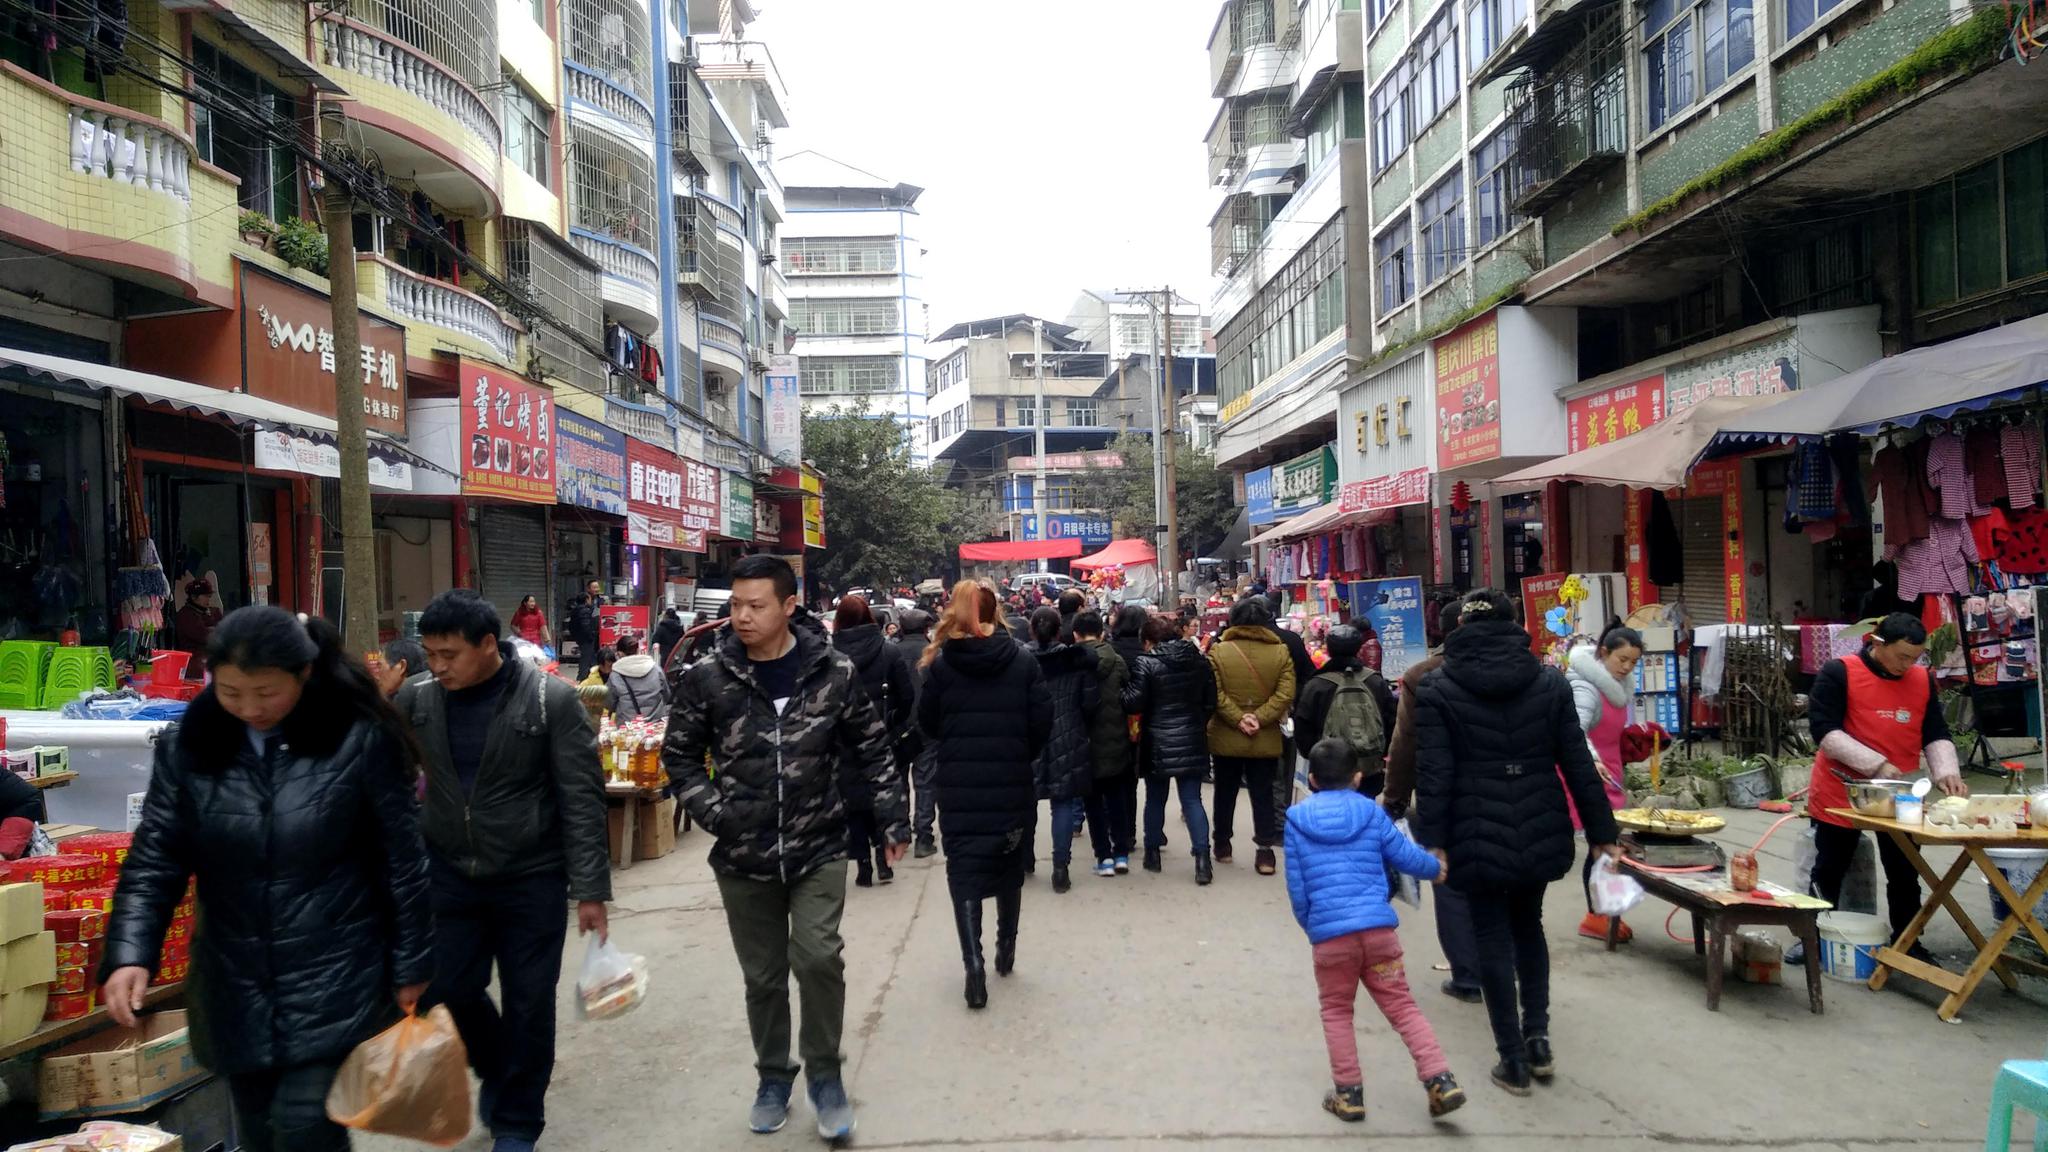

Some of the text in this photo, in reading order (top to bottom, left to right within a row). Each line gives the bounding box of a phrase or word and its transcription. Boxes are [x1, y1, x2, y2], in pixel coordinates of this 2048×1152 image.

[271, 315, 399, 391] WO 智手机
[1438, 321, 1497, 378] 重庆川菜馆
[363, 397, 399, 420] G体验厅
[473, 376, 549, 446] 董记烤卤
